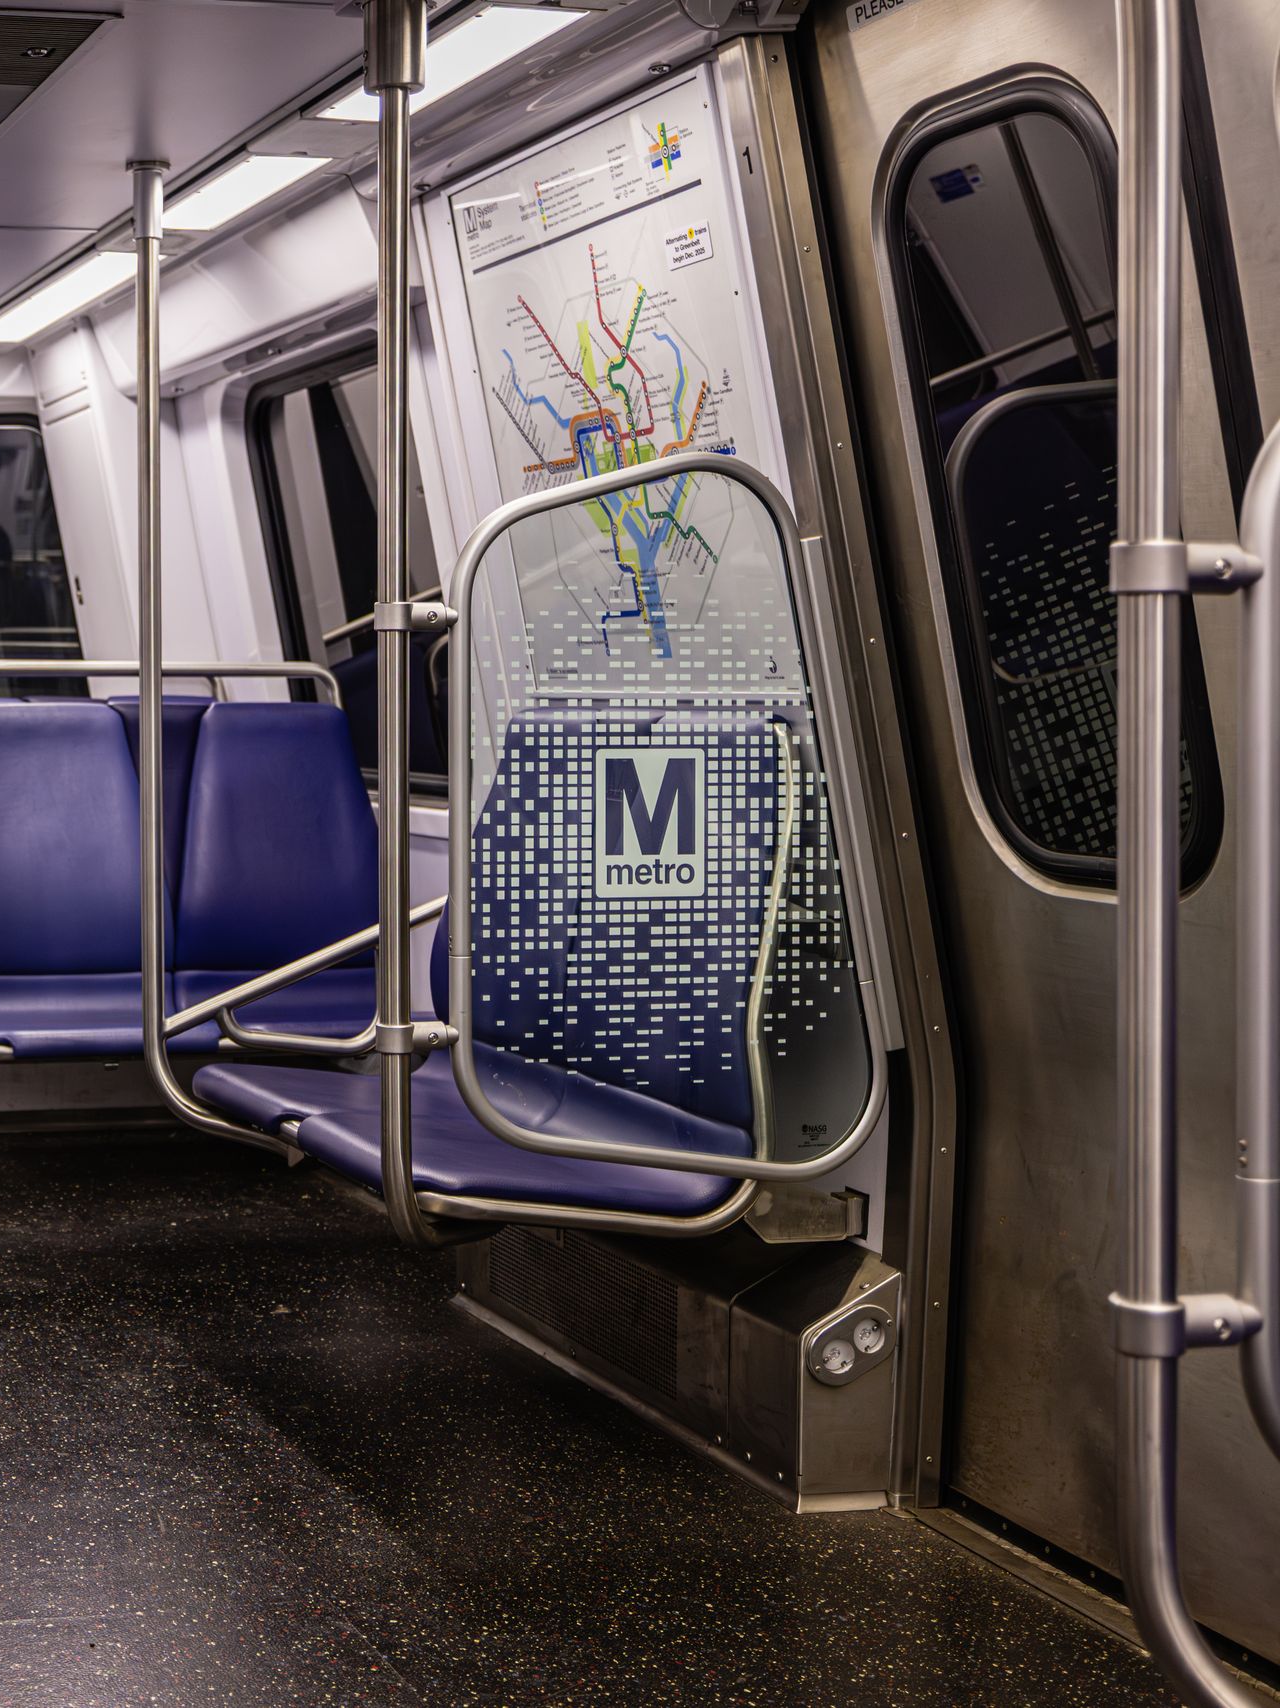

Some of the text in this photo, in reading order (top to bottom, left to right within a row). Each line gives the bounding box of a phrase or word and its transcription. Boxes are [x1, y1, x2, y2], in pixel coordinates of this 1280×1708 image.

[742, 146, 753, 175] 1
[477, 202, 498, 220] System
[479, 219, 492, 231] Map
[666, 227, 707, 245] Alternating trains
[680, 239, 700, 251] Greenbelt
[673, 255, 684, 263] begin
[606, 859, 696, 885] metro
